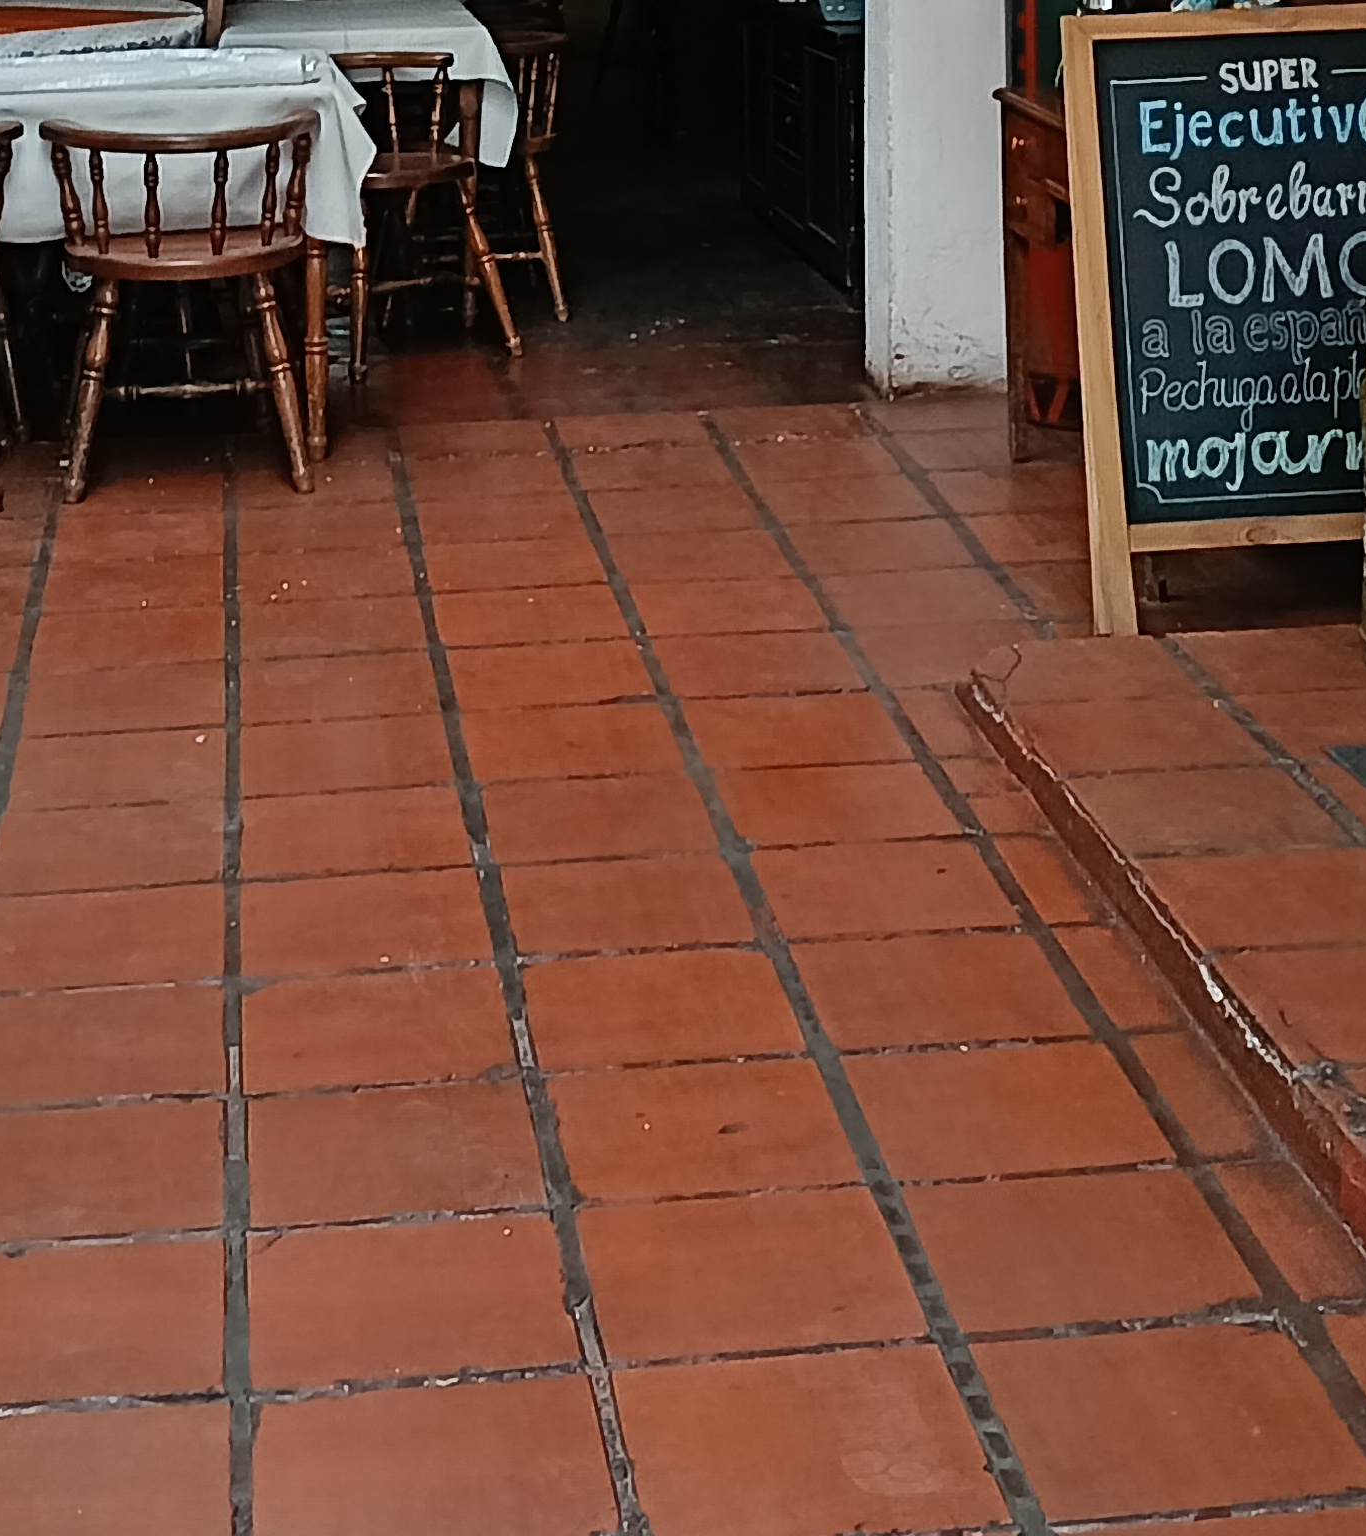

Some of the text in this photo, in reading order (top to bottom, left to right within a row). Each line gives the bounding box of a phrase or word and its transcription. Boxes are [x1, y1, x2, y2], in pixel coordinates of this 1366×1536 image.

[1218, 57, 1320, 95] SUPER
[1141, 318, 1170, 358] a
[1191, 309, 1236, 356] la
[1138, 360, 1277, 432] Pechuga
